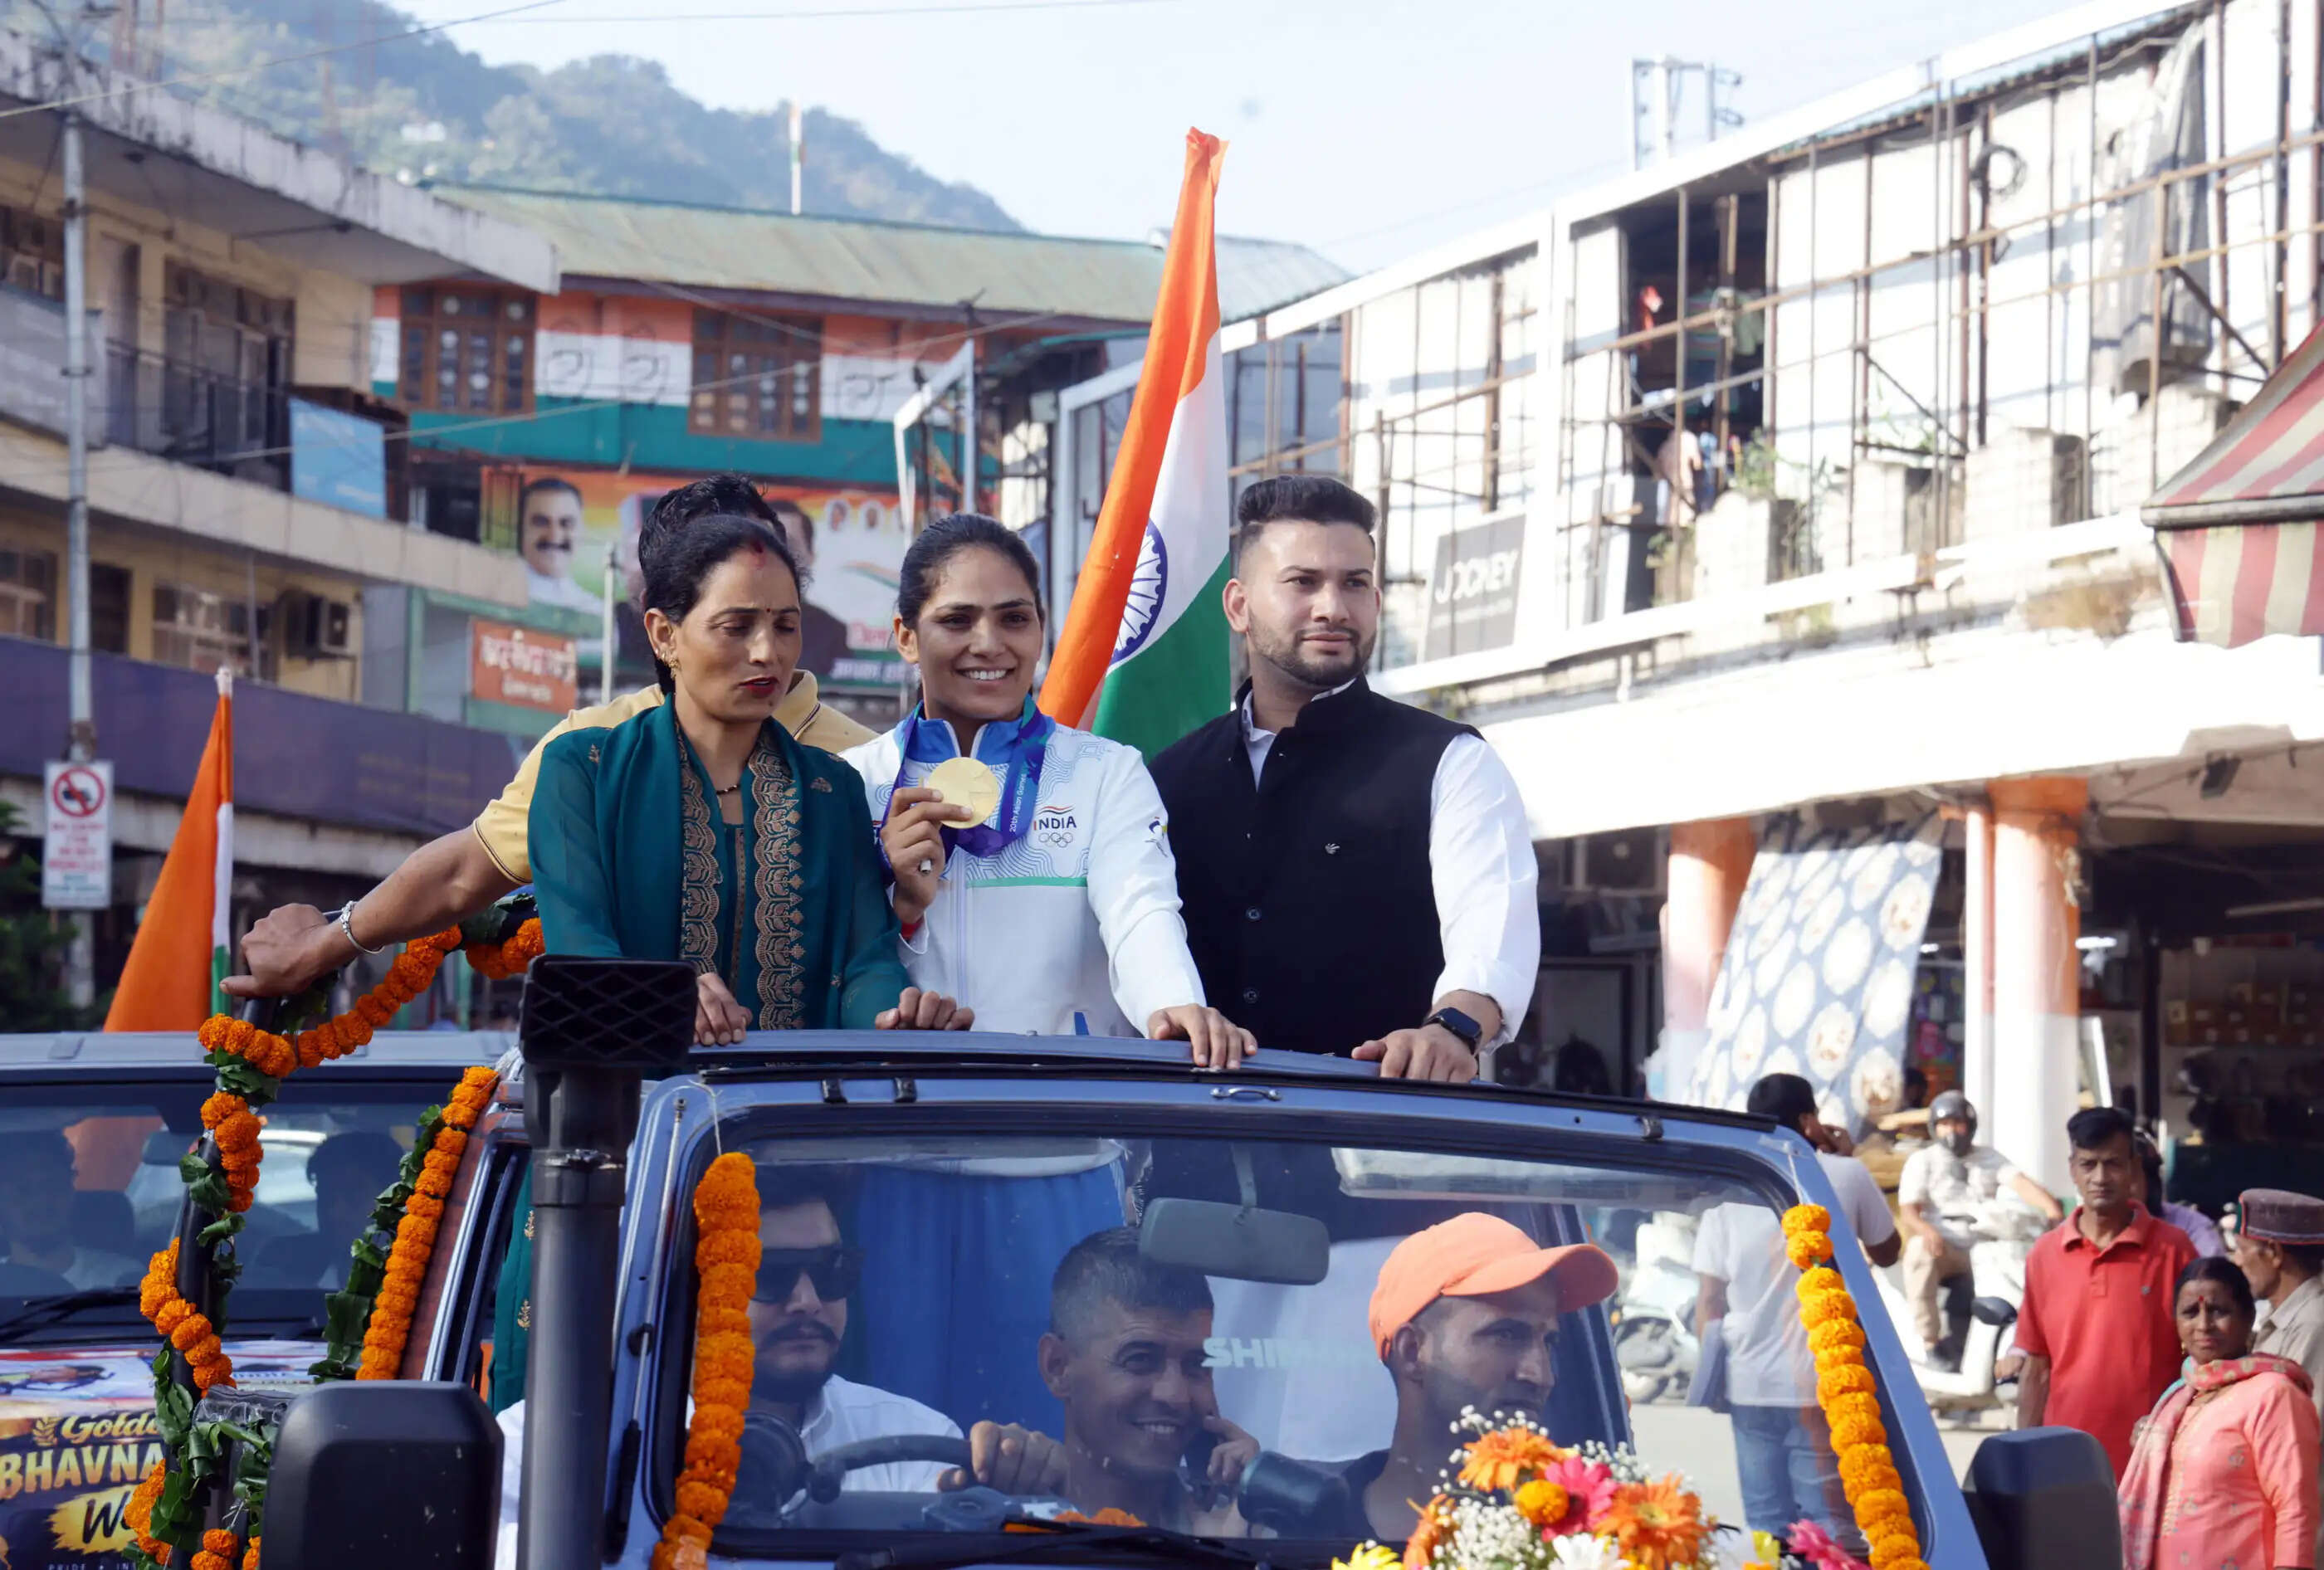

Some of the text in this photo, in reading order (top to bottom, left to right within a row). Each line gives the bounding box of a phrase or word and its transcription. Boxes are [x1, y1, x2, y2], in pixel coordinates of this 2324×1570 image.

[1008, 774, 1028, 833] 20th Asian Games
[1033, 816, 1077, 831] INDIA
[61, 1412, 160, 1444] Golde
[0, 1442, 164, 1500] BHAVNA
